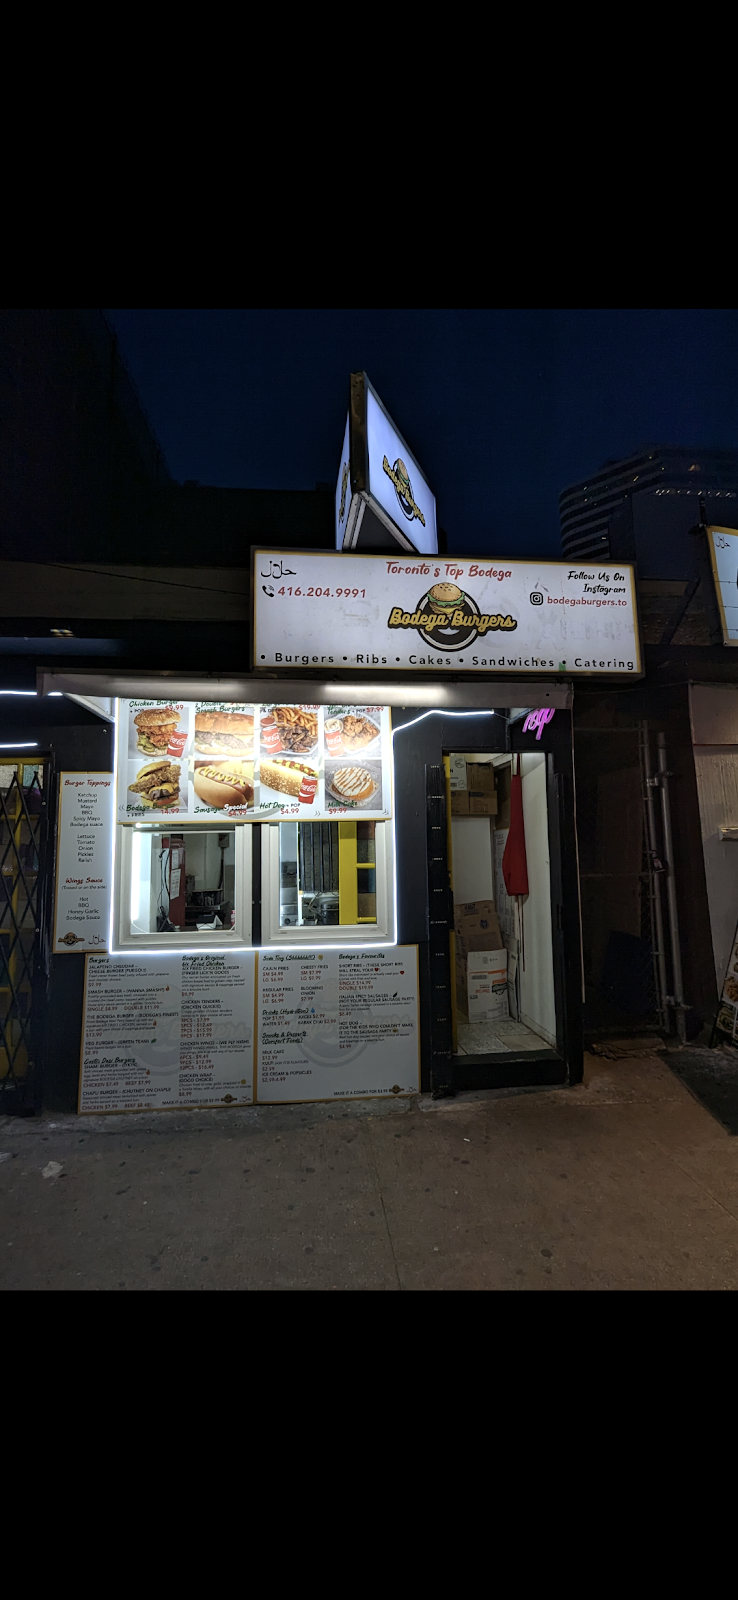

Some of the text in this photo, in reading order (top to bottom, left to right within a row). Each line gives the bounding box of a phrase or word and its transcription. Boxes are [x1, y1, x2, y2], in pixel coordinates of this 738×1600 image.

[261, 560, 297, 578] حلال
[386, 561, 512, 581] Toronto's Top Bodega
[568, 570, 625, 581] Follow Us On
[278, 587, 366, 598] 416.204.9991
[583, 584, 625, 595] Instagram
[547, 596, 627, 607] bodegaburgers.to
[389, 608, 516, 632] Bodega Burgers
[275, 653, 634, 670] Burgers Ribs Cakes Sandwiches Catering
[87, 779, 111, 787] Toppings
